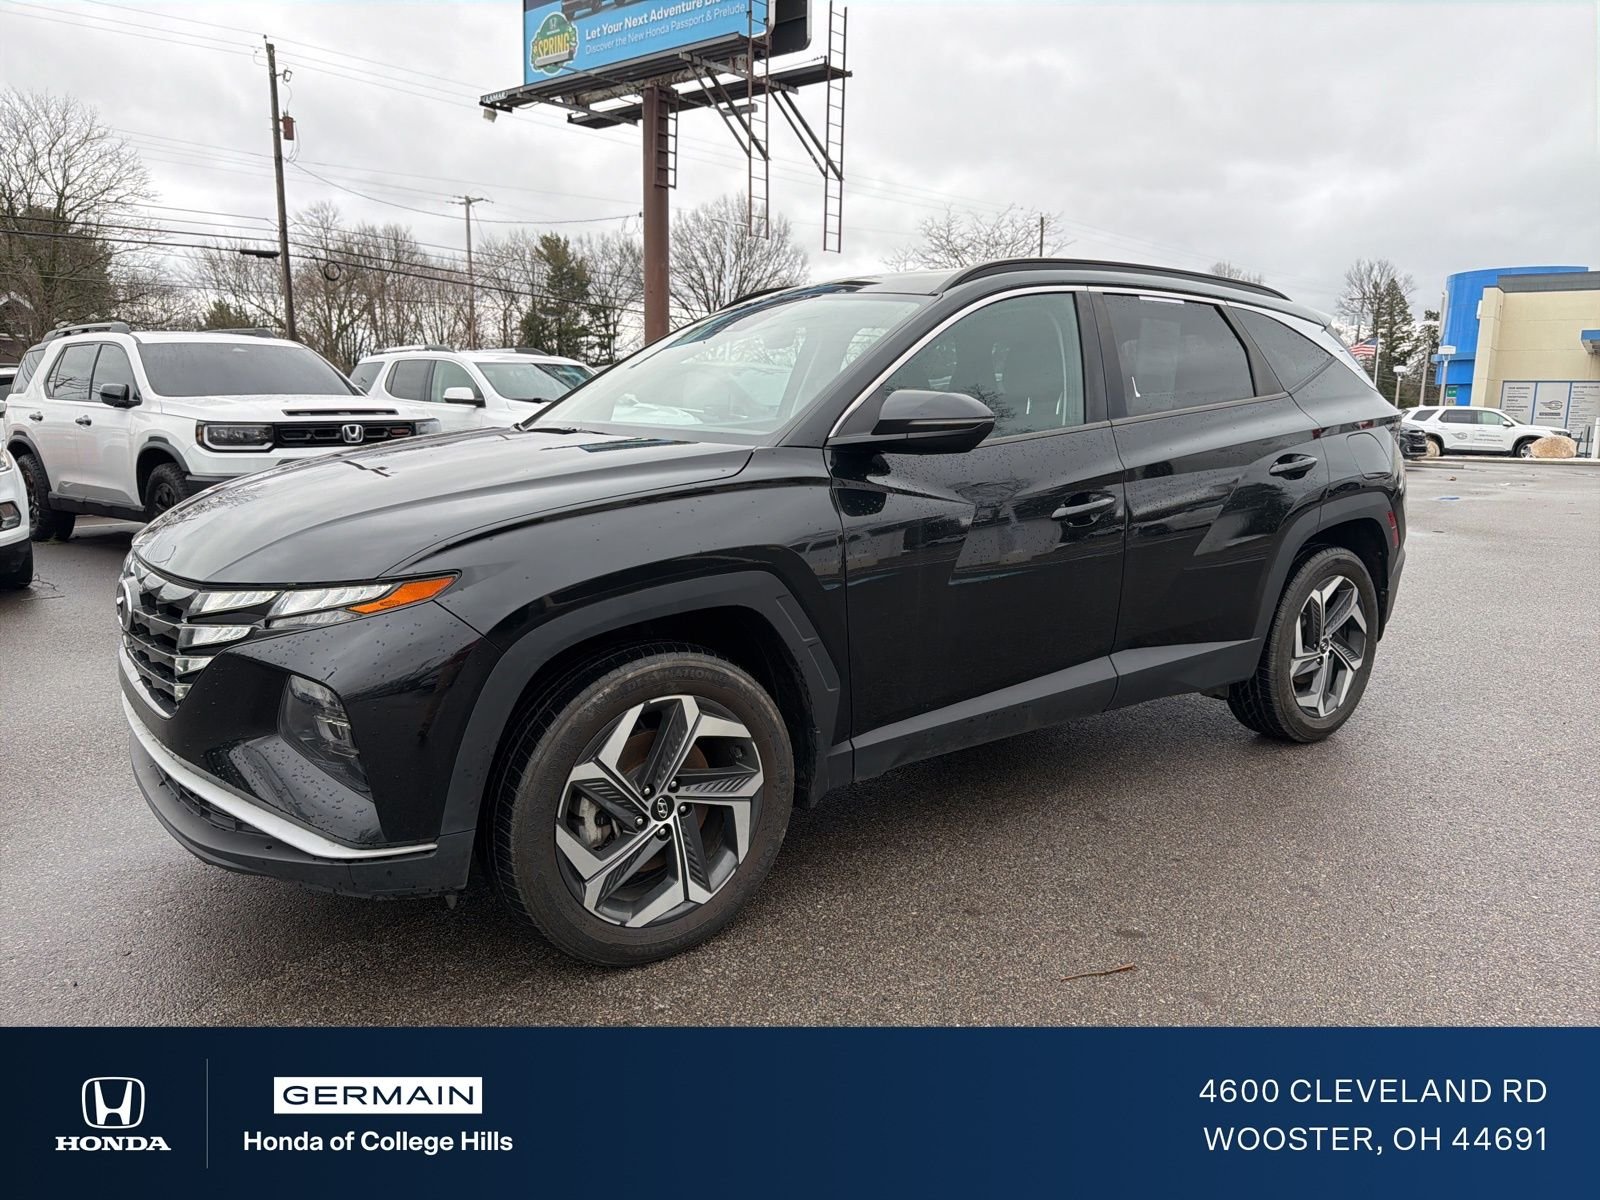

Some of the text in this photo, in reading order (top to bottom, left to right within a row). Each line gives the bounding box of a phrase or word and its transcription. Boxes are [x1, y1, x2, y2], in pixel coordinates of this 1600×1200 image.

[585, 0, 702, 40] Let Your Next Adventure
[585, 39, 614, 55] Discover
[615, 36, 627, 47] the
[628, 33, 645, 44] New
[646, 25, 670, 38] Honda
[671, 15, 705, 31] Passport
[706, 10, 712, 21] &
[714, 3, 745, 19] Prelude
[538, 32, 570, 58] SPRING
